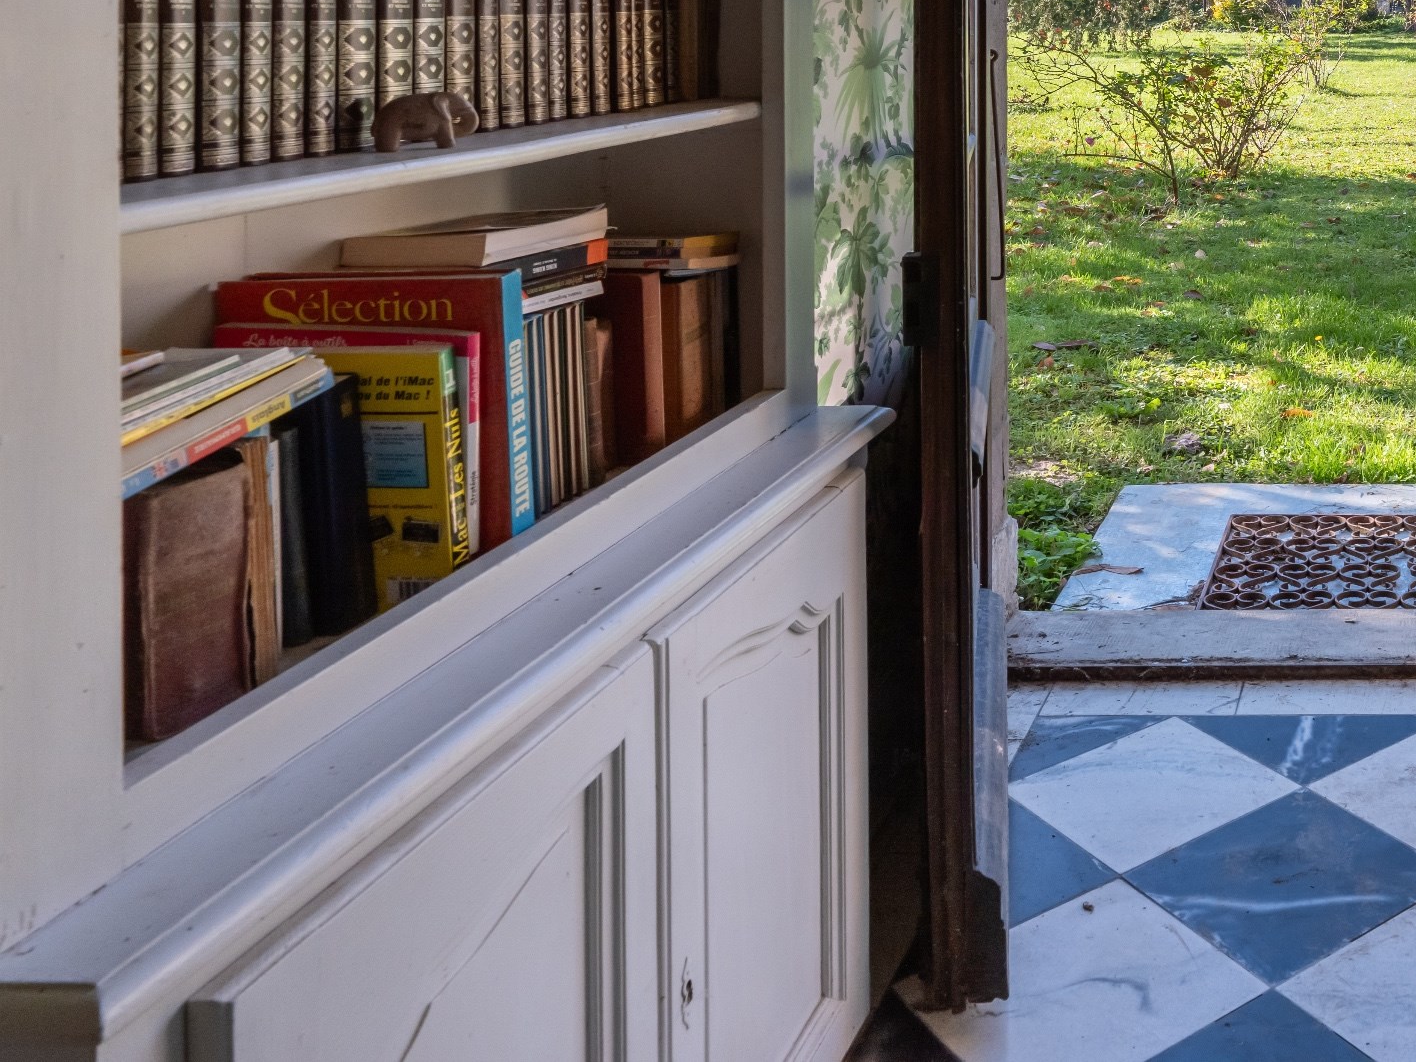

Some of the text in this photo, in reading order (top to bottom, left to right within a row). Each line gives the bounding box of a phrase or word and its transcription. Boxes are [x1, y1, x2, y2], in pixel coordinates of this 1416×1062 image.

[263, 288, 453, 326] Sélection
[375, 390, 390, 401] du
[394, 390, 420, 401] Mac
[376, 375, 390, 387] de
[394, 375, 435, 387] l'iMac
[251, 399, 286, 424] Anglais
[508, 338, 531, 518] GUIDE DE LA ROUTE
[445, 407, 462, 459] Nuls
[450, 462, 467, 503] Les
[469, 470, 477, 506] Stratégie
[453, 516, 471, 566] Mac
